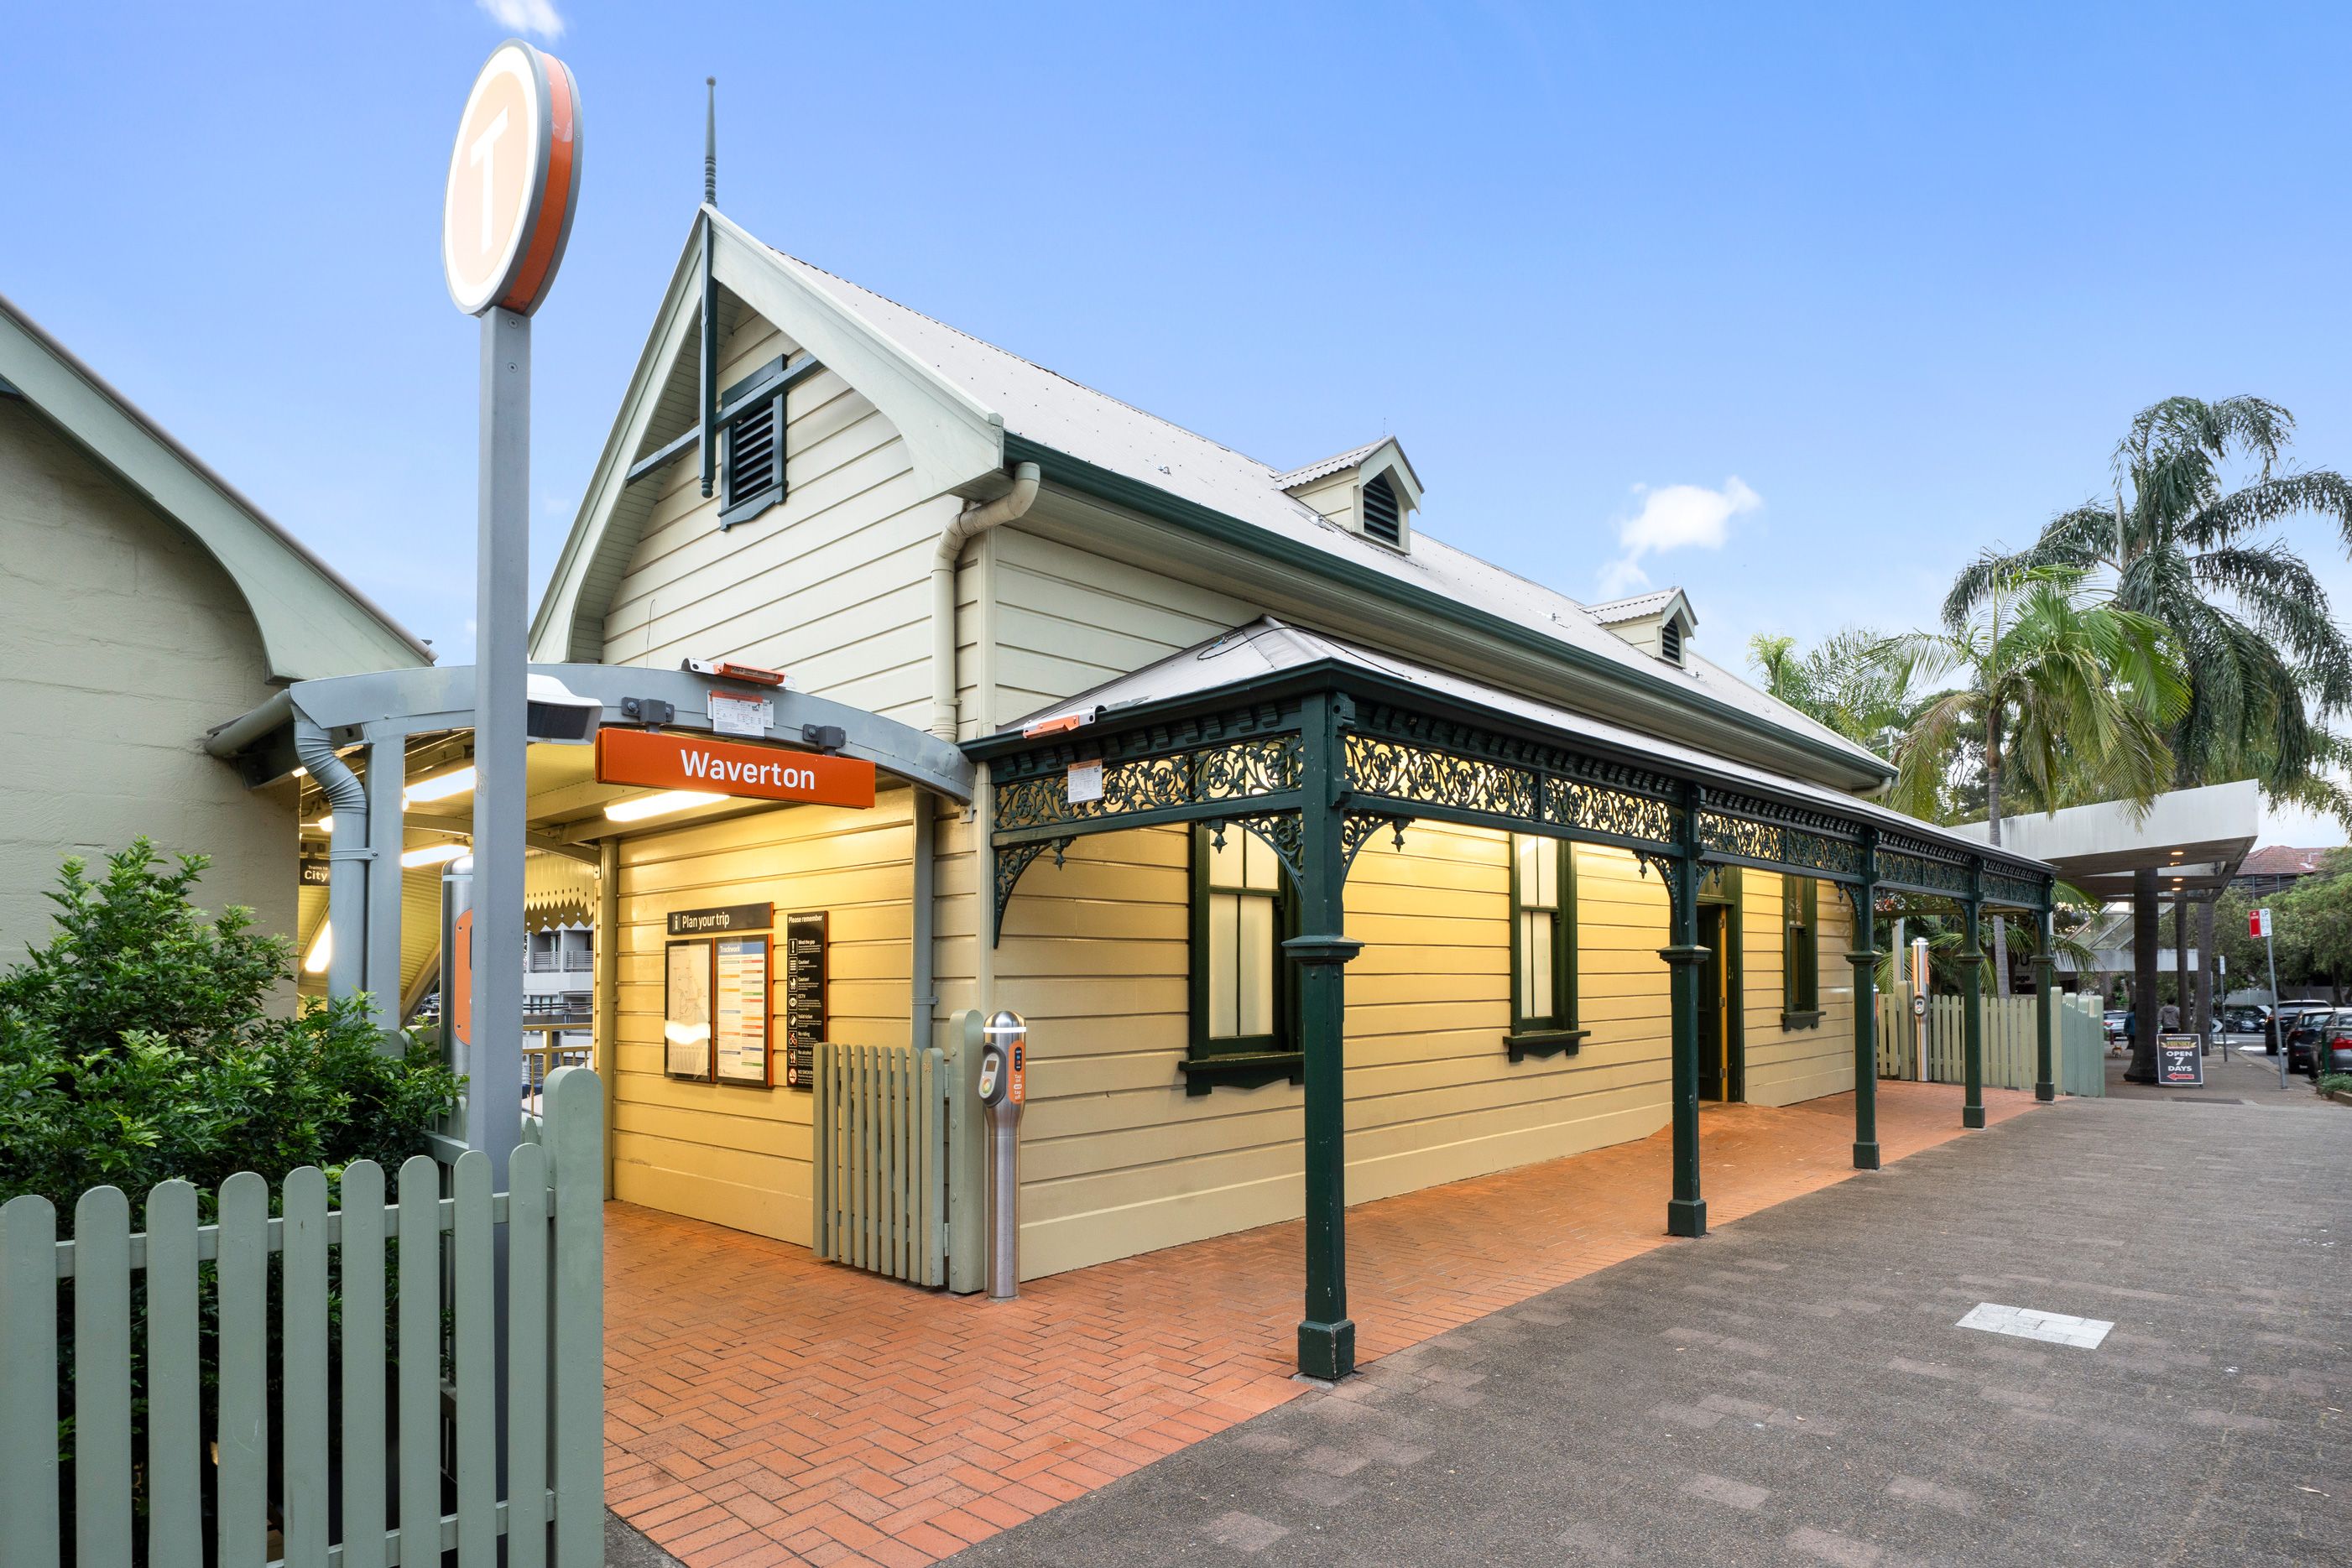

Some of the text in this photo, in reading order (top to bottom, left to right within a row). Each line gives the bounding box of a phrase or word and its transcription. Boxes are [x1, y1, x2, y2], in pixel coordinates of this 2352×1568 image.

[470, 105, 508, 255] T
[681, 749, 815, 790] Waverton
[305, 870, 328, 882] City
[682, 914, 698, 929] Plan
[698, 915, 716, 930] your
[716, 911, 730, 928] trip
[802, 914, 822, 923] remember
[2174, 1057, 2184, 1065] 7
